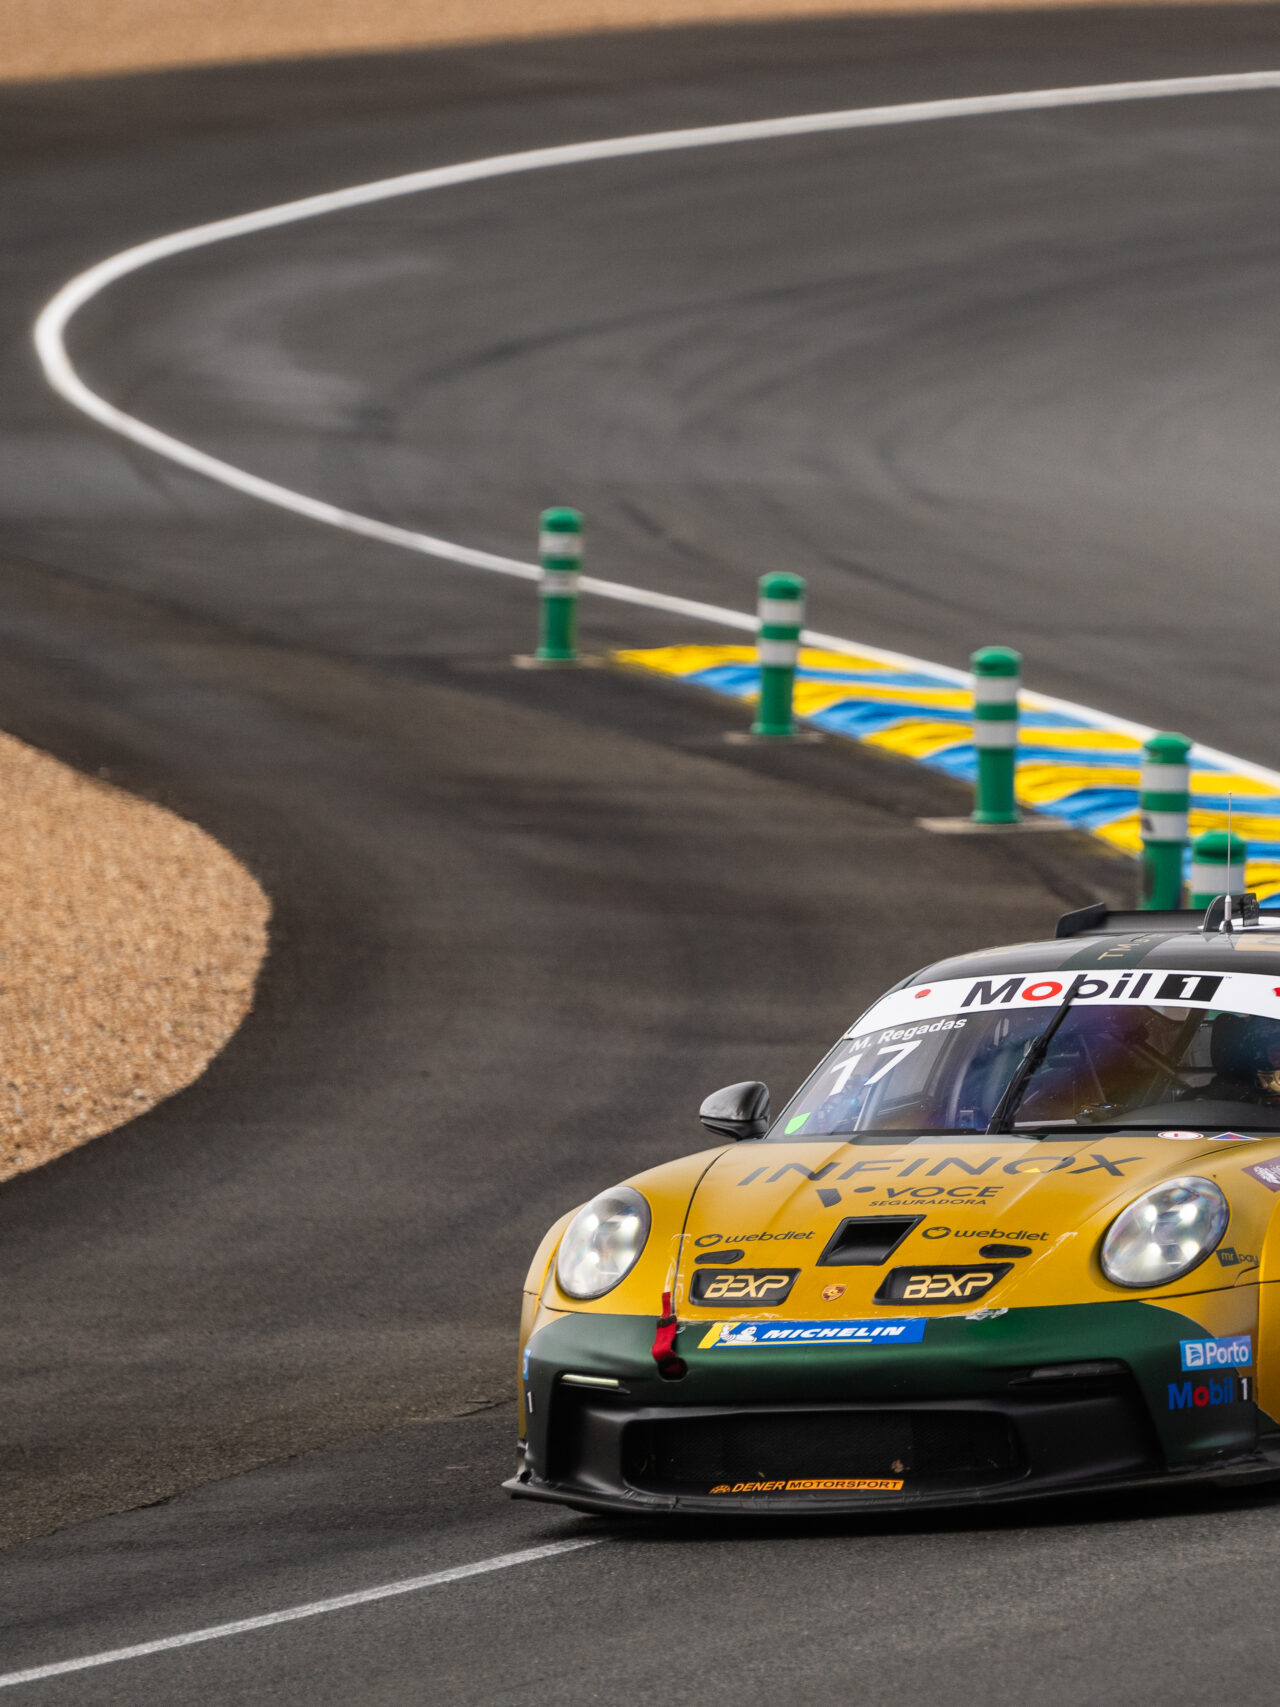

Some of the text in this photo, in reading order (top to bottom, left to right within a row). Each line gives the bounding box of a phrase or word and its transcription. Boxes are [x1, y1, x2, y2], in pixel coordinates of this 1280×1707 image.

[960, 972, 1153, 1008] Mobil
[849, 1016, 968, 1053] M. Regadas
[828, 1039, 922, 1097] 17
[736, 1153, 1148, 1187] INFINOX
[868, 1198, 987, 1207] SEGURADORA
[725, 1230, 817, 1243] webdiet
[953, 1228, 1050, 1242] webdiet
[703, 1274, 790, 1299] BEXP
[902, 1272, 994, 1300] BEXP
[761, 1326, 906, 1340] MICHELIN
[1205, 1341, 1249, 1366] Porto
[1167, 1377, 1234, 1411] Mobil
[731, 1479, 902, 1493] DENER MOTORSPORT
